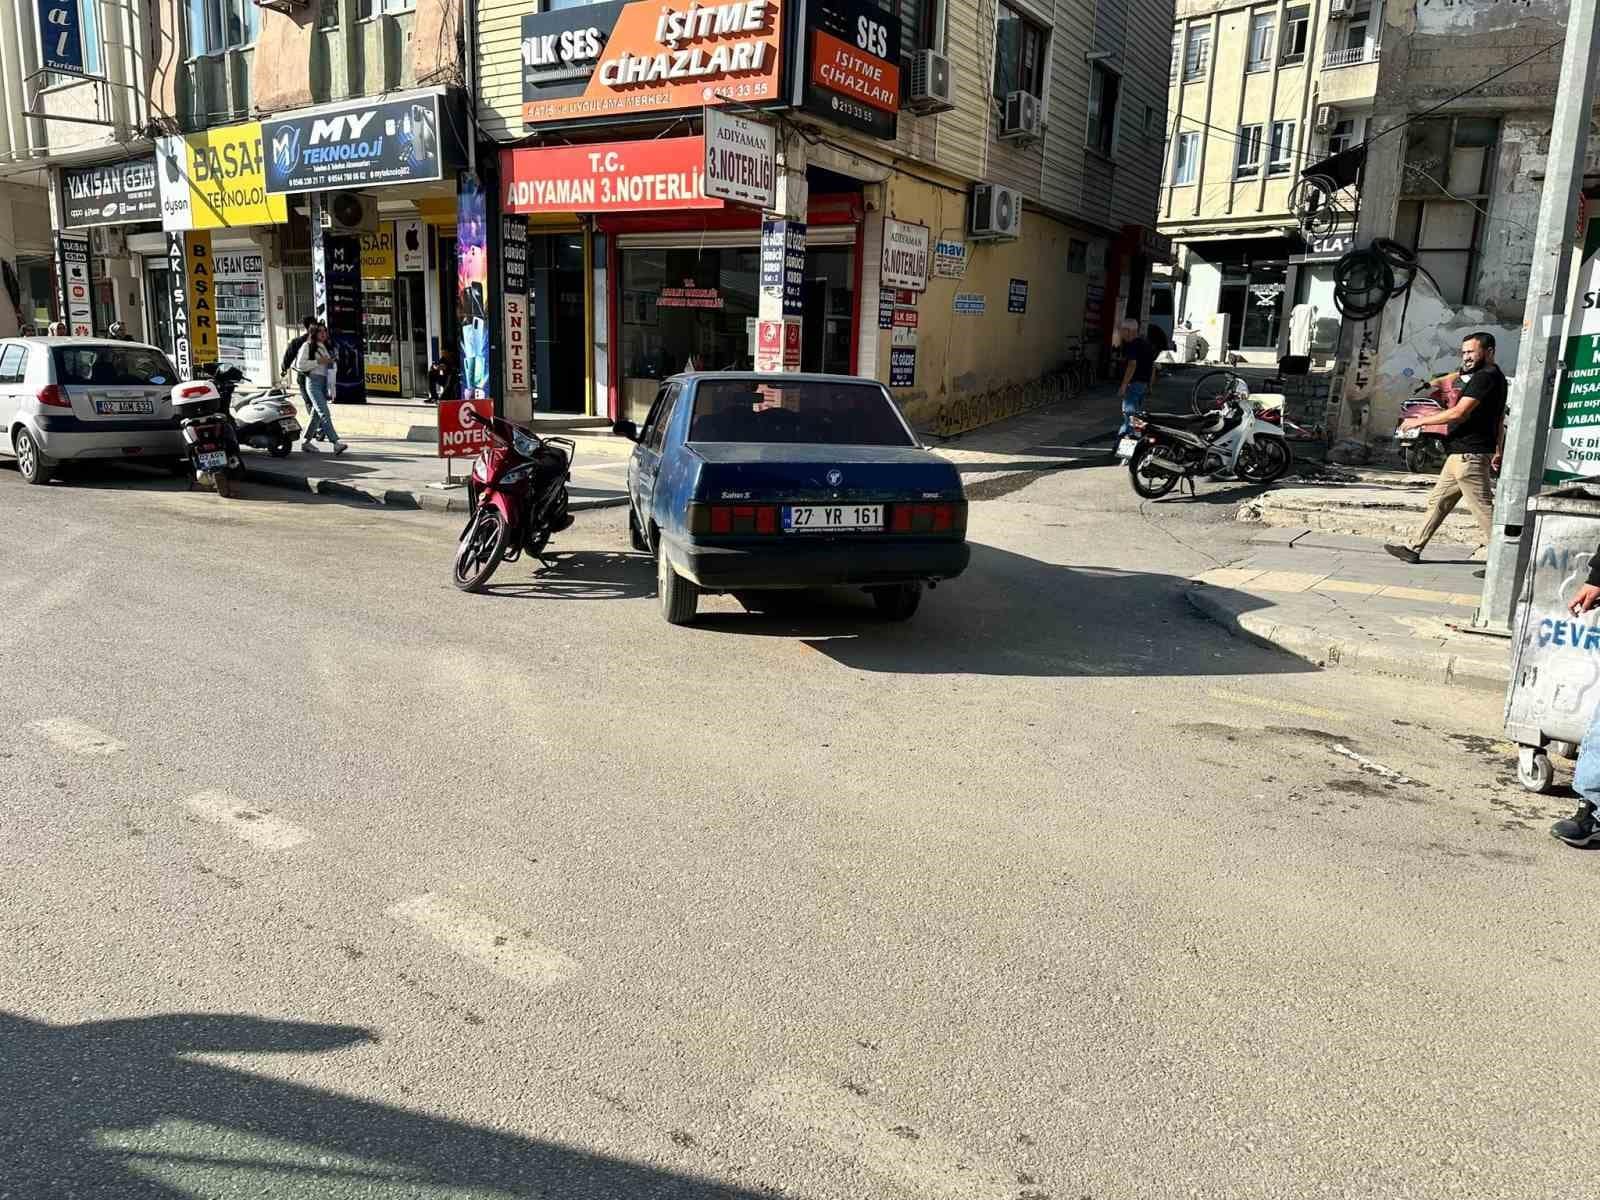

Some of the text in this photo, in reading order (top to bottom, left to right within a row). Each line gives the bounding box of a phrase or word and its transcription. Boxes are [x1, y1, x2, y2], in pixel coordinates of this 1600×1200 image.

[656, 0, 768, 48] İŞİTME
[560, 27, 603, 61] SES
[857, 15, 887, 58] SES
[599, 42, 767, 86] CİHAZLARI
[839, 101, 852, 115] 213
[309, 111, 377, 145] MY
[717, 127, 767, 150] ADIYAMAN
[588, 152, 625, 173] T.C.
[123, 164, 155, 192] GSM
[508, 178, 595, 206] ADIYAMAN
[164, 199, 188, 215] dyson
[936, 242, 965, 257] mavi
[243, 255, 262, 272] GSM
[365, 371, 397, 385] SERVİS
[1570, 437, 1584, 448] VE
[794, 507, 878, 525] 27 YR 161
